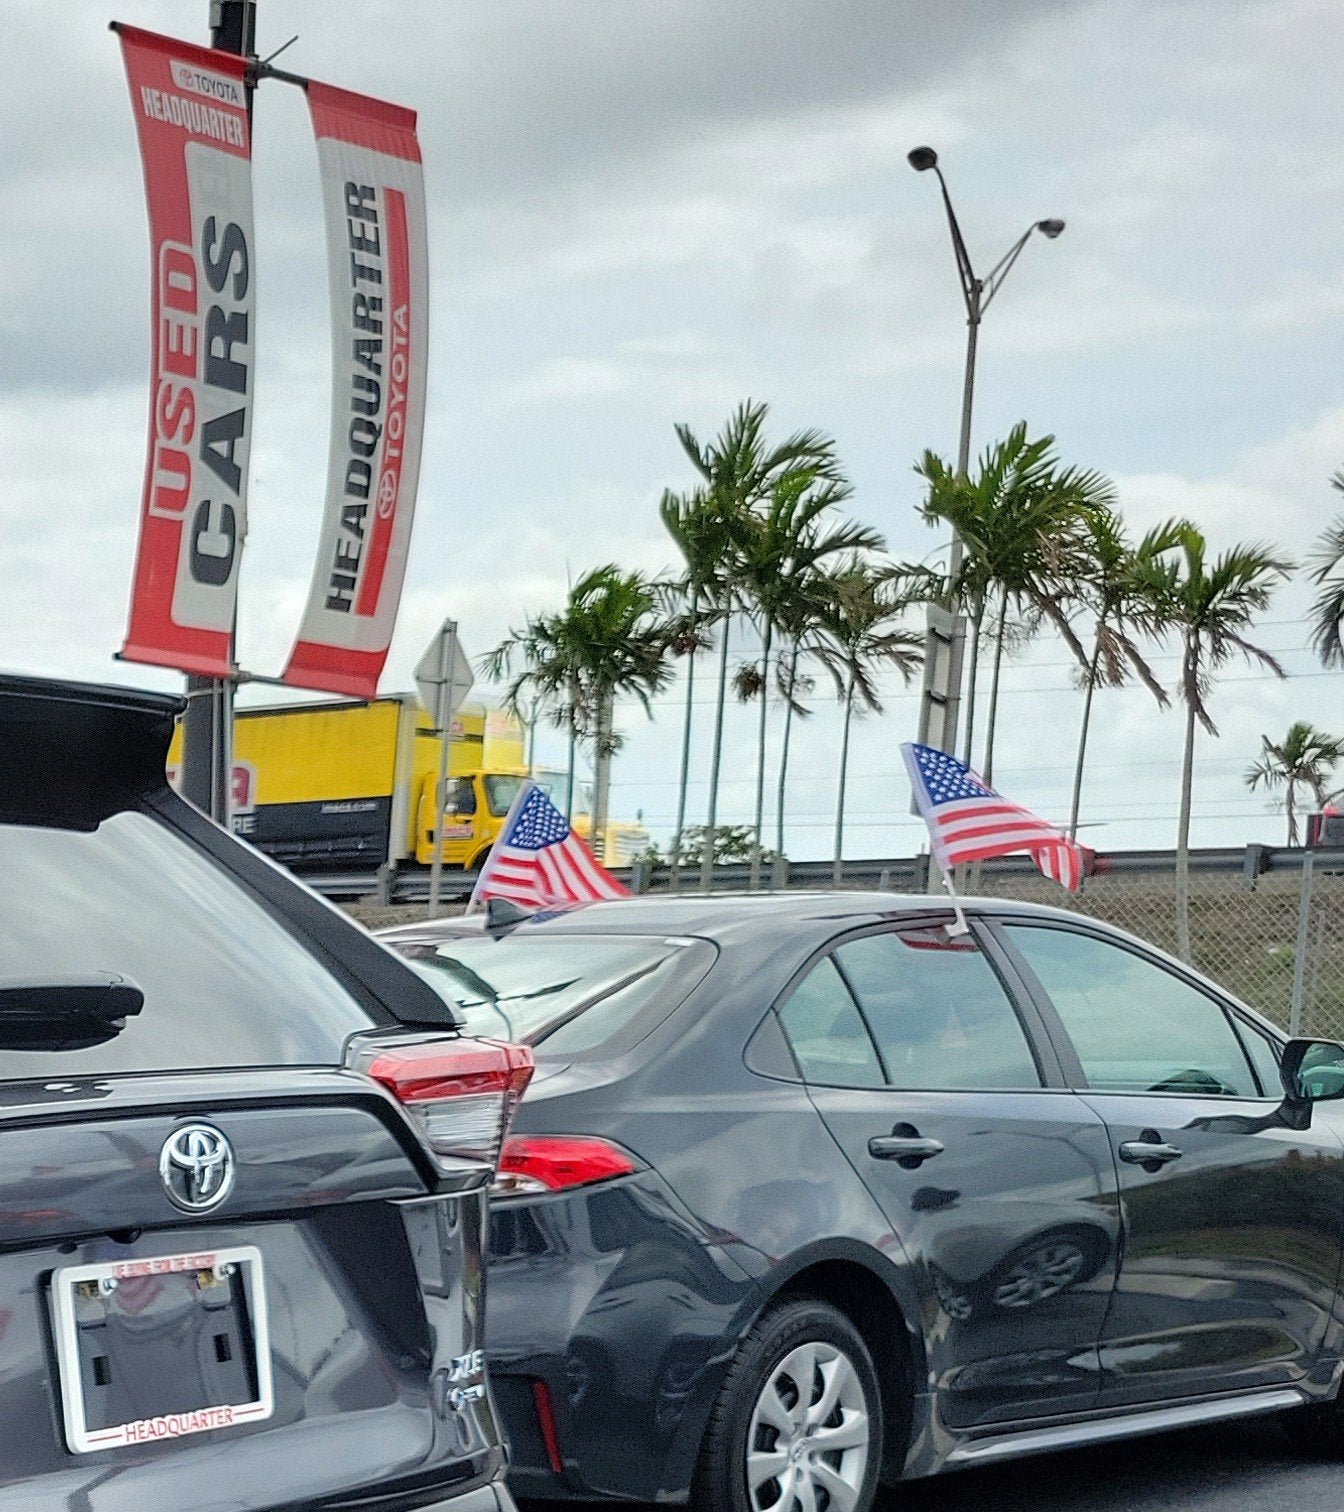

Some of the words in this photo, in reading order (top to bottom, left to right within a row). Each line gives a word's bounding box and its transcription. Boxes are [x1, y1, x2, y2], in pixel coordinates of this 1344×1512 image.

[140, 86, 244, 148] HEADQUARTER
[194, 74, 238, 101] TOYOTA
[150, 239, 198, 521] USED
[189, 216, 249, 586] CARS
[324, 181, 383, 613] HEADQUARTER
[386, 304, 409, 458] TOYOTA
[125, 1407, 234, 1442] HEADQUARTER
